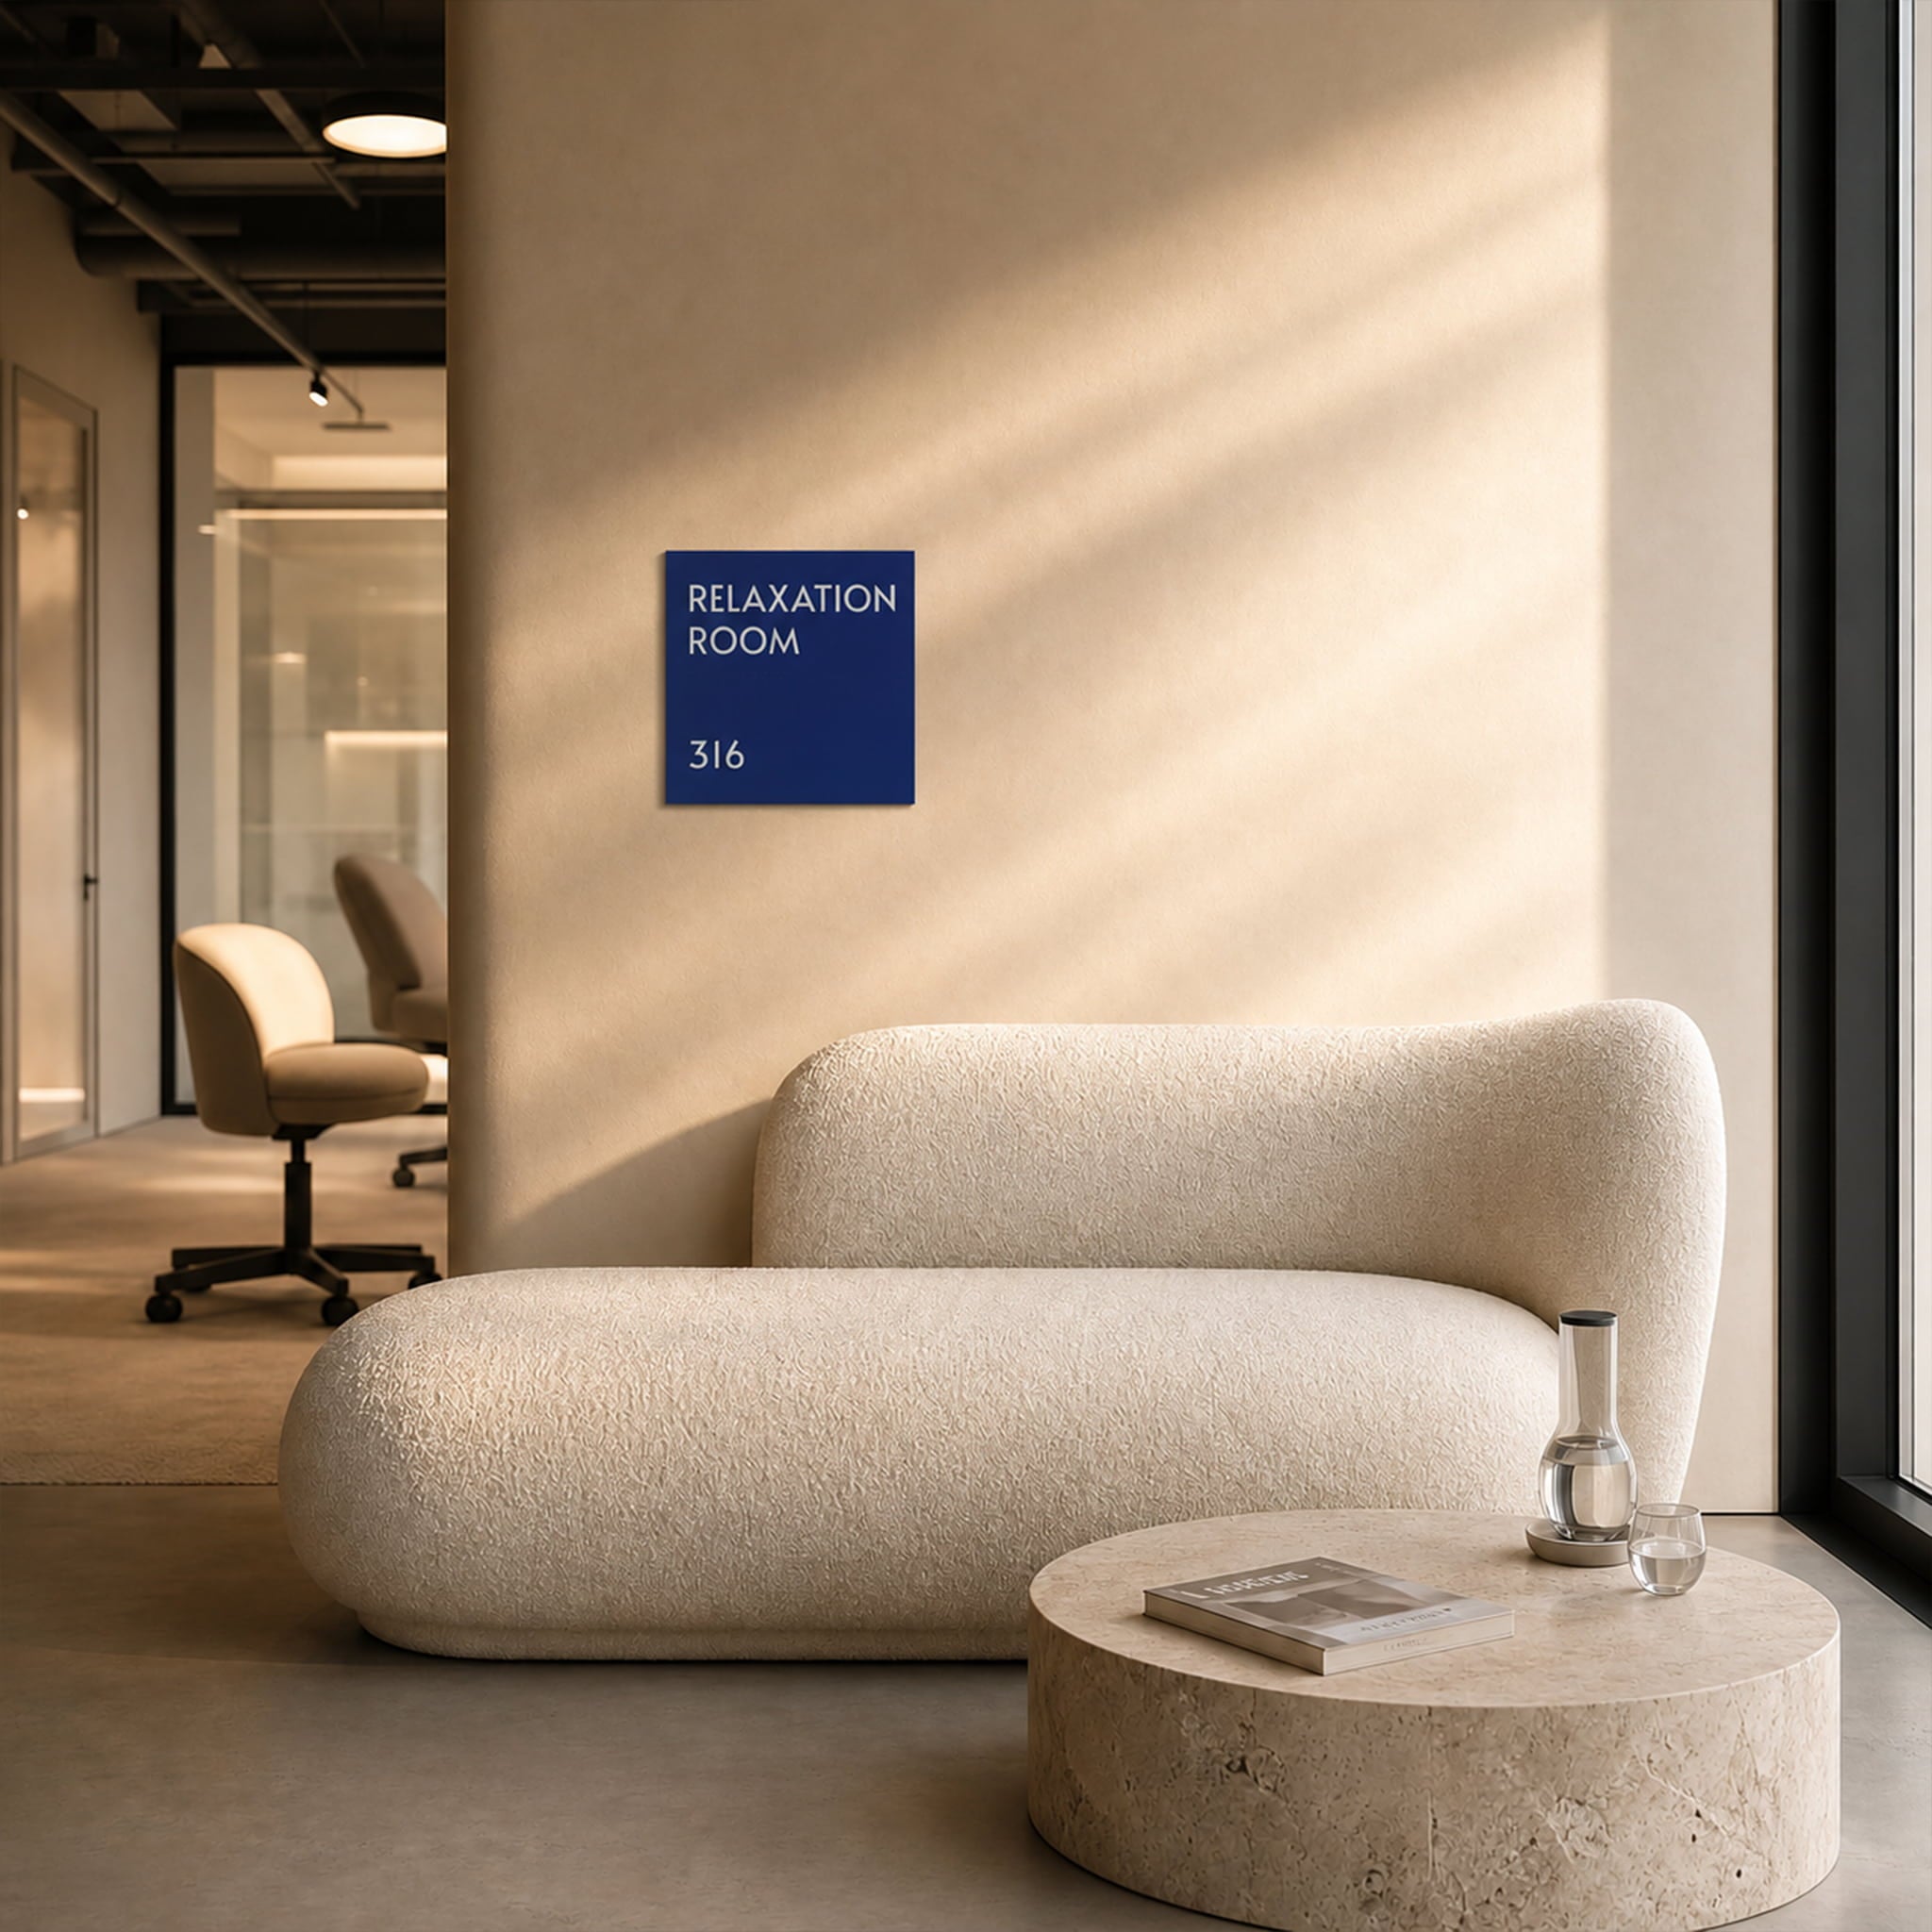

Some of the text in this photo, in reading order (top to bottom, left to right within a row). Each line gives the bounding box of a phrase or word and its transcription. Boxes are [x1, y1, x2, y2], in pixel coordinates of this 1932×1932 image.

[690, 584, 896, 612] RELAXATION
[690, 626, 800, 655] ROOM
[690, 740, 744, 769] 316
